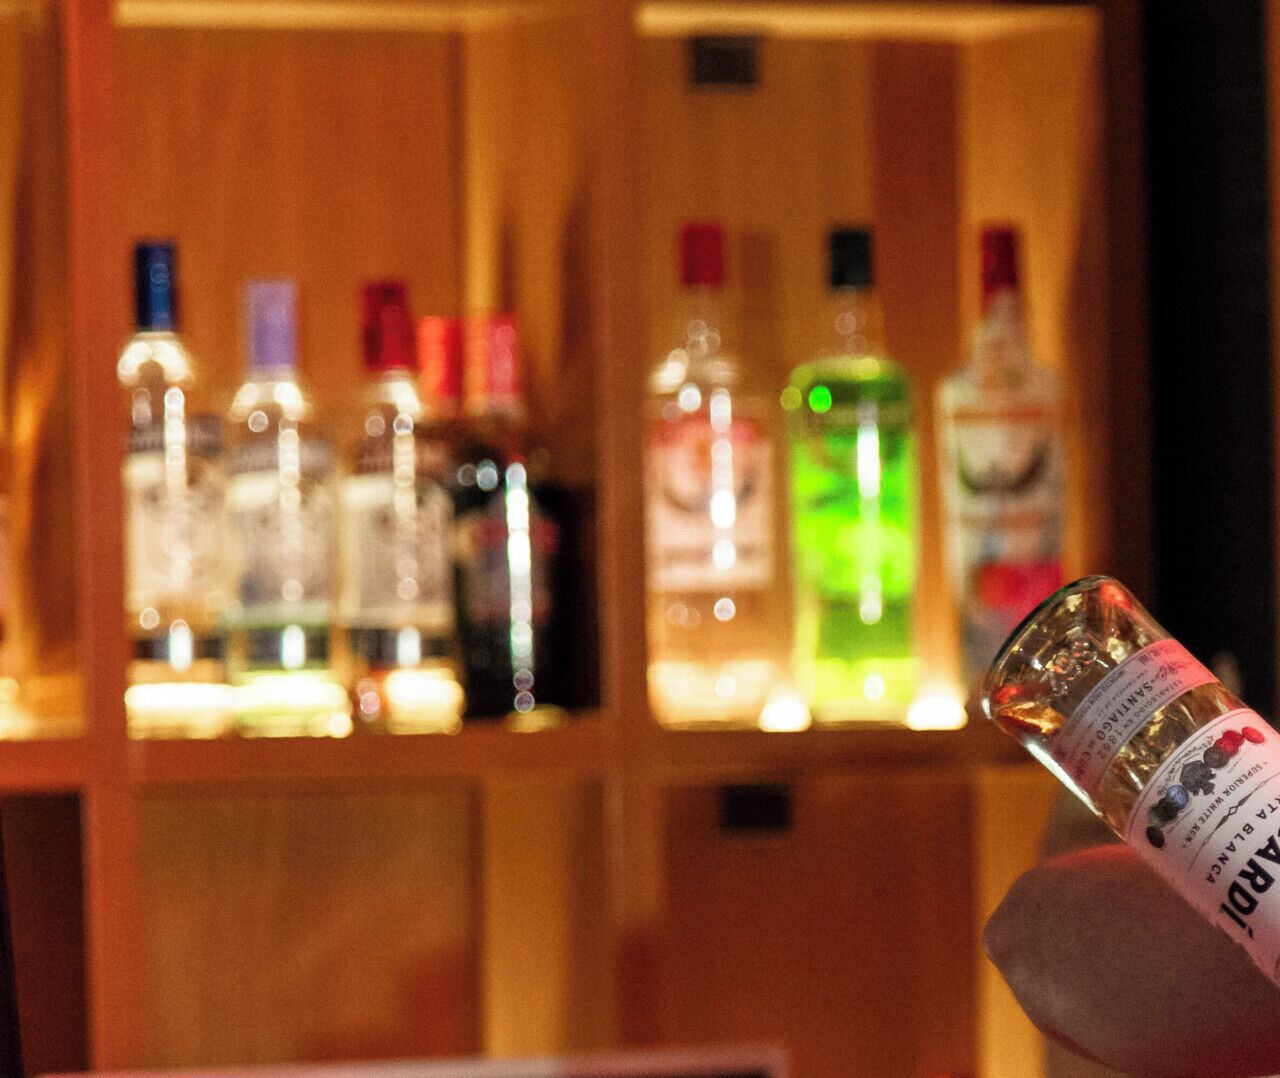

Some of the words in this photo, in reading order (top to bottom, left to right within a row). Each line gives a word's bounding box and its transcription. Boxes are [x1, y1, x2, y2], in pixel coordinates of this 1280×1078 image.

[1096, 682, 1153, 740] SANTIAGO
[1223, 764, 1262, 796] SUPERIOR
[1199, 797, 1224, 823] WHITE
[1185, 824, 1200, 842] RUM
[1206, 823, 1254, 883] BLANCA
